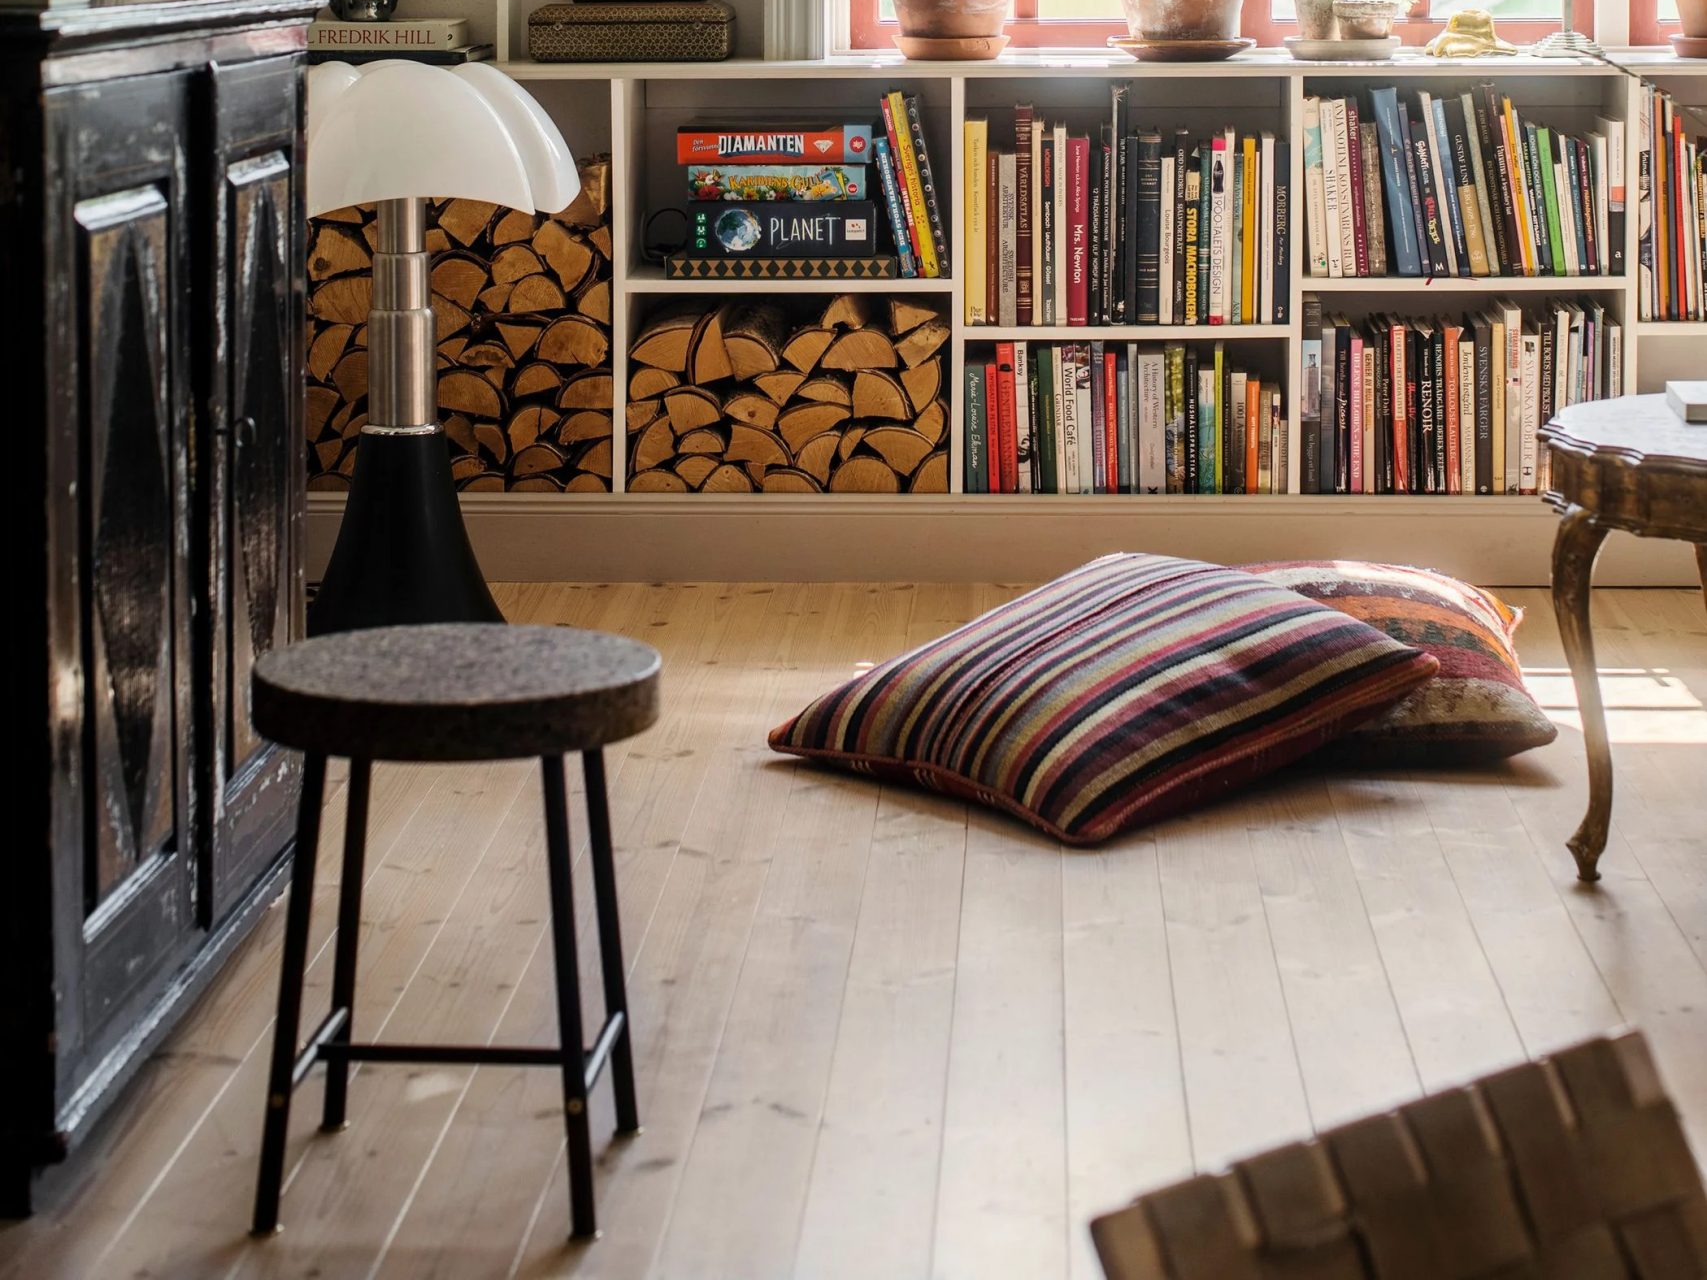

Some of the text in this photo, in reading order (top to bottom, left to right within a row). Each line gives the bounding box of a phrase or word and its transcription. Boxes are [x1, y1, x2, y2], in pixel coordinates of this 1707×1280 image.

[318, 29, 391, 45] FREDRIK
[395, 29, 436, 45] HILL
[718, 134, 805, 156] DIAMANTEN
[1347, 109, 1359, 141] shaker
[728, 175, 789, 190] KARIBIENS
[902, 144, 915, 177] Sveriges
[909, 178, 921, 206] historia
[1323, 168, 1338, 211] SHAKER
[1333, 102, 1354, 271] ANJA NOTINI KONSTNÄRENS RUM
[1454, 133, 1472, 205] GUSTAF LUNDBERG
[1528, 133, 1542, 200] KONST, KÖN OCH BLICK
[880, 152, 906, 246] DEN STORA HANDBOKEN
[1020, 167, 1029, 229] VÄRLDSATLAS
[1276, 185, 1286, 235] MORBERG
[770, 216, 841, 246] PLANET
[1074, 224, 1084, 284] Mrs. Newton
[1092, 235, 1099, 243] AV
[1162, 232, 1171, 264] Bourgeois
[1212, 195, 1223, 295] 1900-TALETS DESIGN
[1186, 207, 1197, 319] STORA MACHOBOKEN
[1233, 300, 1241, 318] A&K
[1016, 349, 1024, 376] Banksy
[1142, 361, 1150, 402] Architecture
[1149, 367, 1159, 393] History
[1363, 352, 1373, 387] GENIER AV
[1461, 349, 1472, 382] Jordens
[1541, 330, 1551, 415] TILL BORDS MED PROUST
[968, 371, 982, 469] Marie-Louise Ekman
[1064, 368, 1077, 446] World Food Café
[1151, 400, 1160, 429] Western
[1235, 401, 1245, 419] 1001
[1352, 352, 1360, 478] HELENE BILLGREN THE END
[1382, 378, 1390, 416] Peter Dahl
[1420, 379, 1432, 434] RENOIR
[1434, 342, 1444, 451] RENOIRS TRÄDGÅRD DEREK
[1460, 381, 1472, 416] lustgård
[1478, 345, 1488, 440] SVENSKA FÄRGER
[1521, 359, 1535, 461] SVENSKA MÖBLER
[999, 379, 1015, 479] GENTLEMANNEN
[1188, 398, 1196, 478] HUSHÅLLSPRAKTIKA
[1448, 379, 1457, 463] TOULOUSE-LAUTREC
